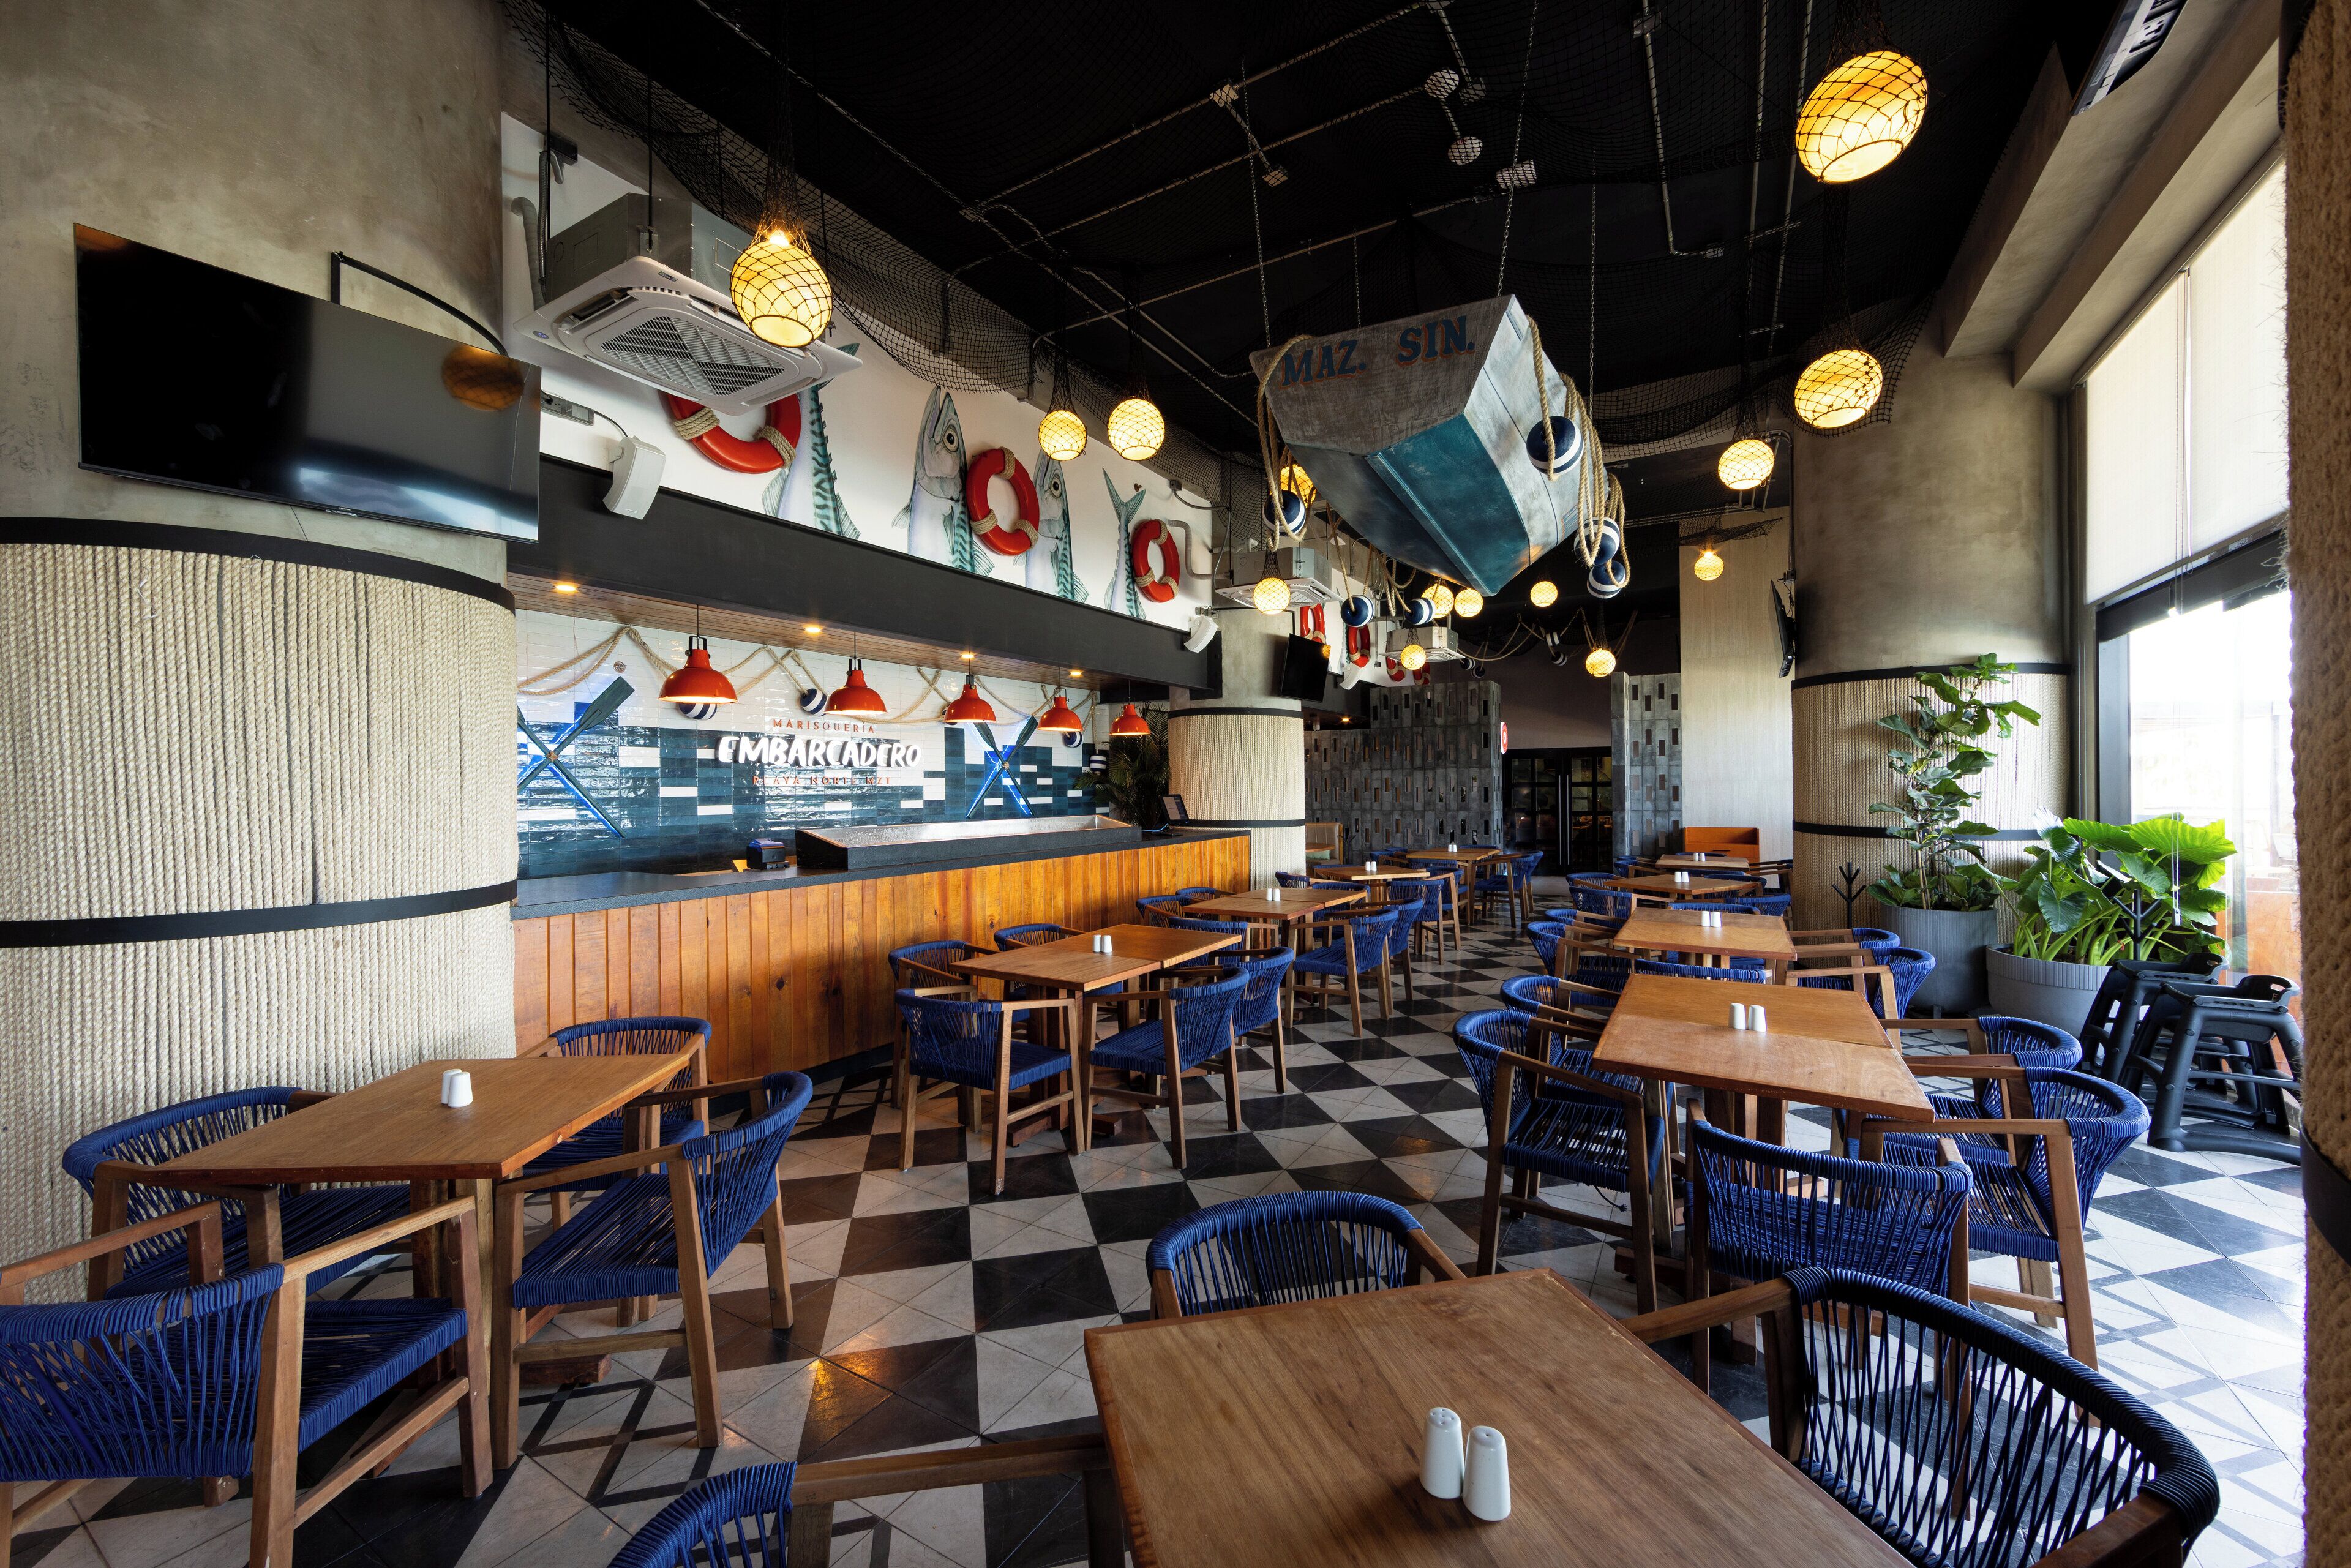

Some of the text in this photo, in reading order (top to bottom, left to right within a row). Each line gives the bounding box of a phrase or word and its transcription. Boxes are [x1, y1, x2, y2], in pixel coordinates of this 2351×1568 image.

[1280, 315, 1475, 389] MAZ. SIN.
[773, 718, 875, 733] MARISQUERÍA
[717, 735, 923, 768] EMBARCADERO
[752, 775, 801, 785] PLAYA
[810, 776, 858, 785] NORTE
